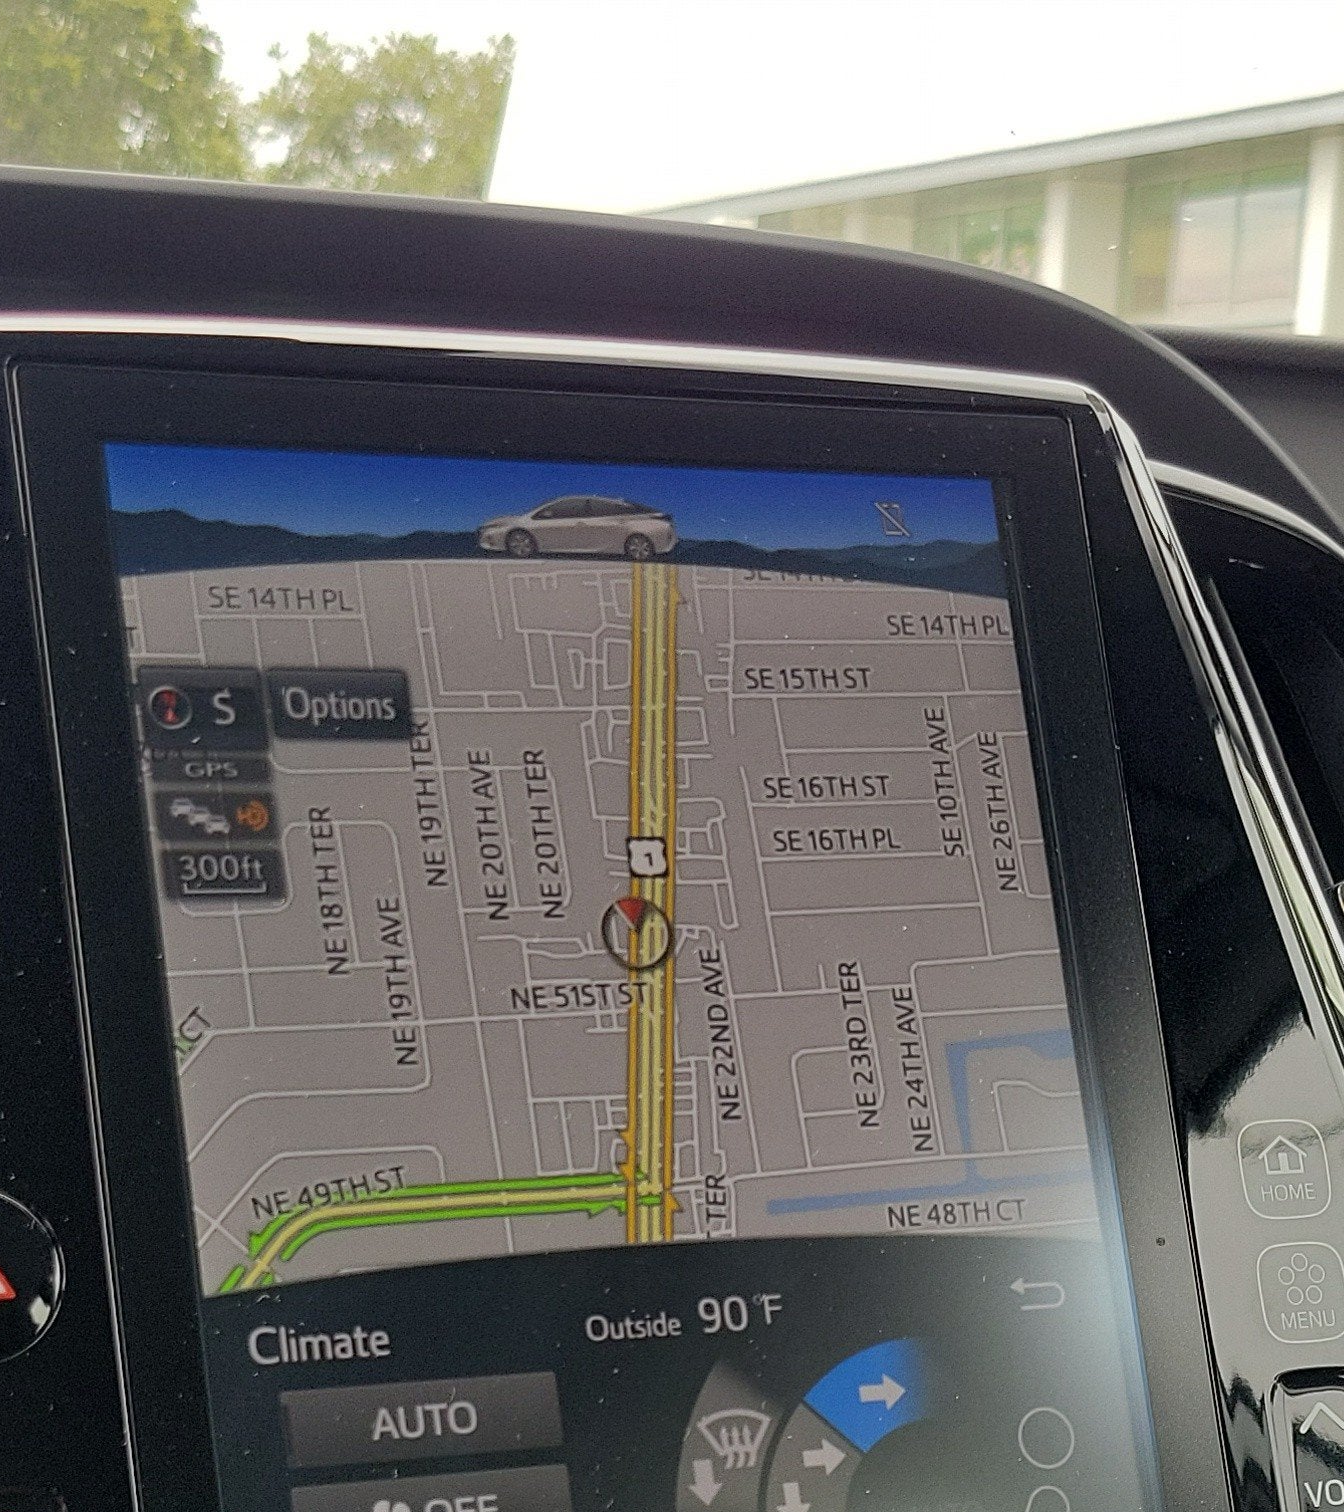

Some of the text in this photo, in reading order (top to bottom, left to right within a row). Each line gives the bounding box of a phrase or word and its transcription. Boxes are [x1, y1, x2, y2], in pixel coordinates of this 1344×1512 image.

[208, 587, 353, 611] SE 14TH PL
[887, 615, 1010, 636] SE 14TH PL
[745, 667, 870, 689] SE 15TH ST
[214, 692, 236, 725] S
[284, 687, 395, 725] Options
[185, 762, 237, 778] GPS
[763, 775, 890, 798] SE 16TH ST
[925, 708, 964, 856] SE 10TH AVE
[410, 718, 447, 888] NE 19TH TER
[978, 731, 1019, 892] NE 26TH AVE
[468, 749, 508, 920] NE 20TH AVE
[524, 749, 564, 918] NE 20TH TER
[773, 828, 900, 852] SE 16TH PL
[180, 855, 263, 882] 300ft
[310, 806, 350, 974] NE 18TH TER
[378, 897, 418, 1065] NE 19TH AVE
[511, 983, 646, 1009] NE 51ST ST
[700, 950, 741, 1120] NE 22ND AVE
[838, 961, 879, 1127] NE 23RD TER
[893, 987, 934, 1153] NE 24TH AVE
[251, 1166, 406, 1219] NE 49TH ST
[1261, 1183, 1315, 1201] HOME
[888, 1200, 1025, 1227] NE 48TH CT
[586, 1314, 681, 1341] Outside
[1281, 1310, 1335, 1330] MENU
[248, 1326, 390, 1365] Climate
[371, 1401, 477, 1441] AUTO
